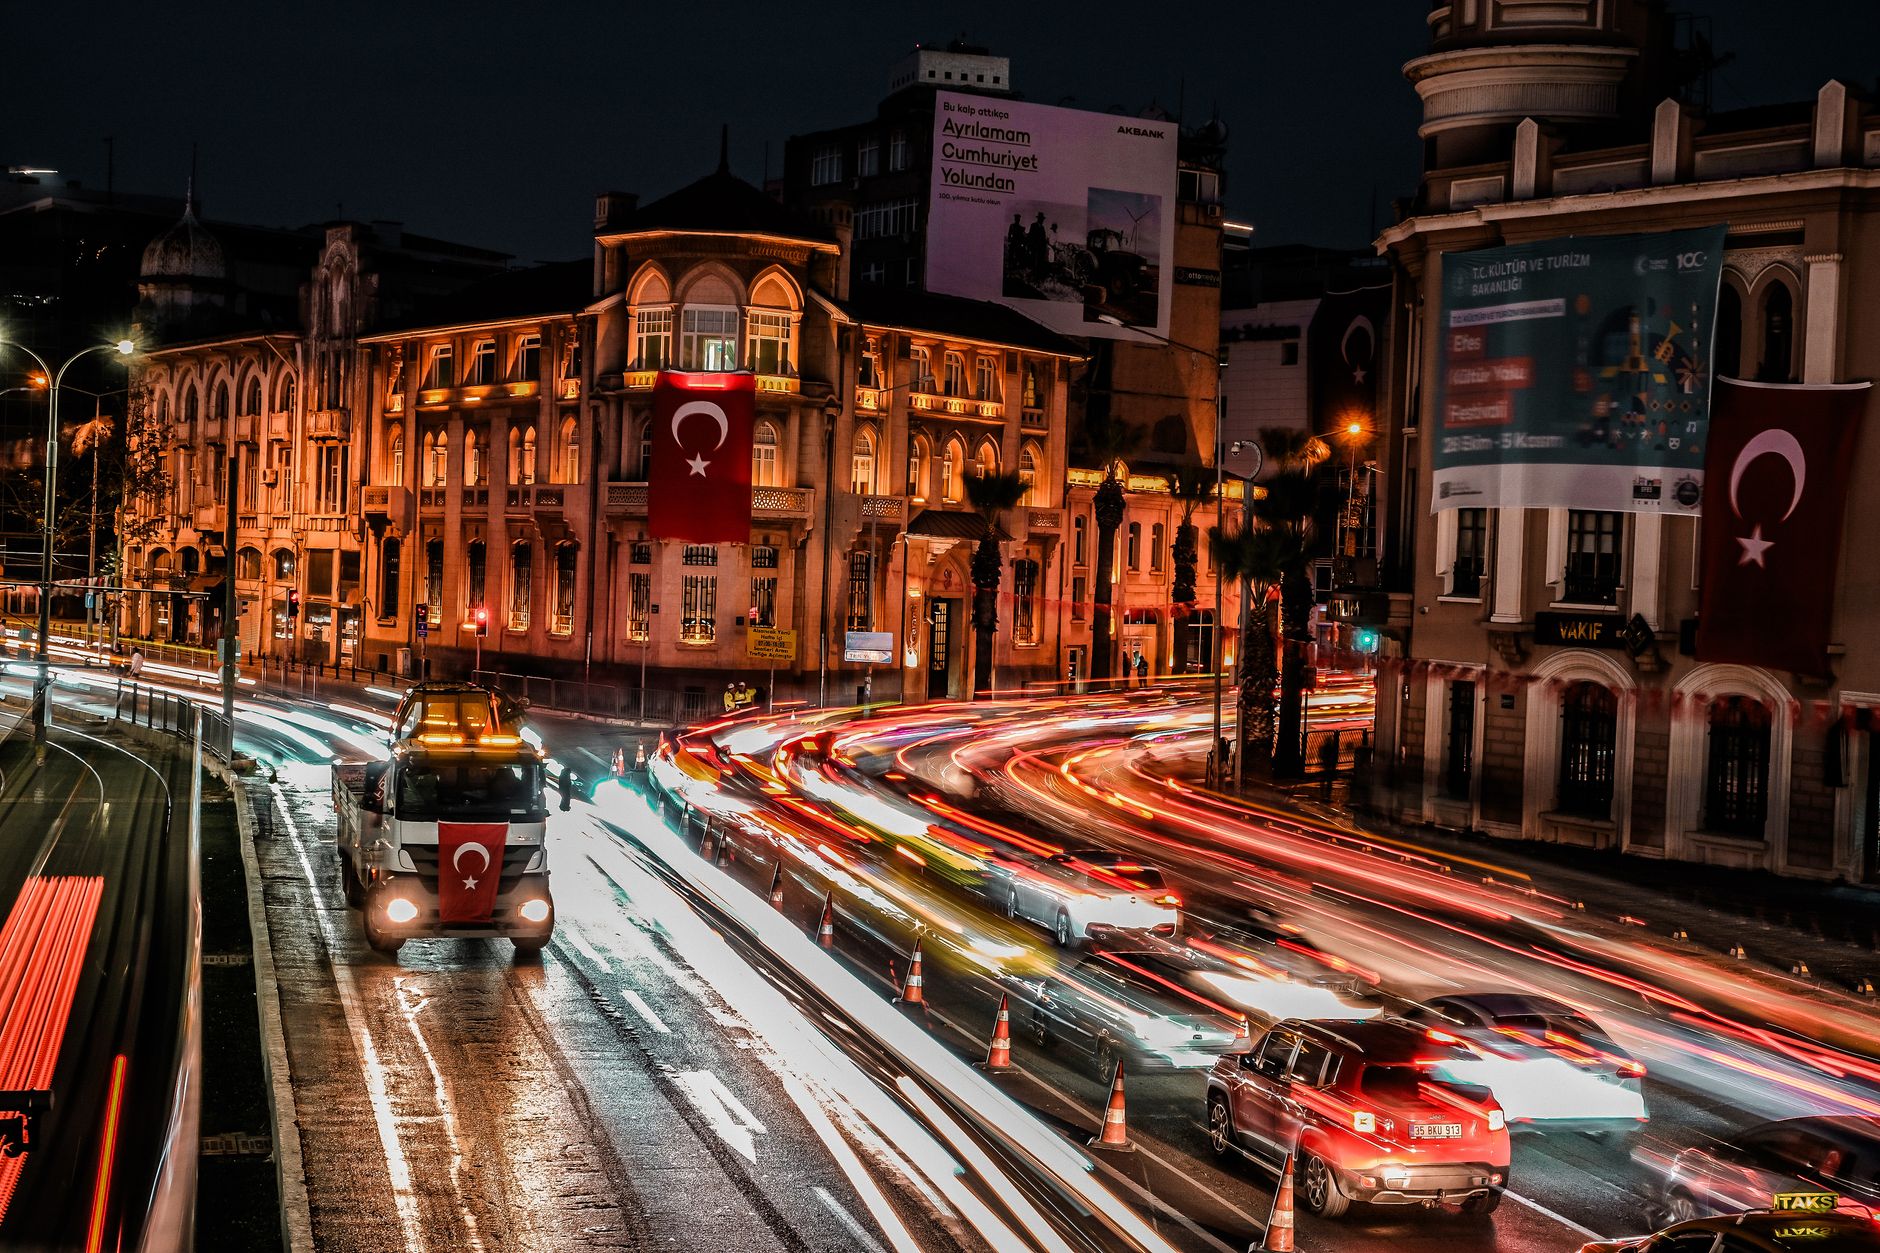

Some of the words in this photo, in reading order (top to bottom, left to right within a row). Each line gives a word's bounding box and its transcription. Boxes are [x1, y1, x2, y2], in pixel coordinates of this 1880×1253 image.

[943, 102, 955, 112] Bu
[957, 104, 976, 117] kalp
[978, 108, 1009, 120] attıkça
[942, 117, 1031, 144] Ayrılamam
[1117, 126, 1165, 139] AKBANK
[942, 142, 1038, 172] Cumhuriyet
[941, 167, 1015, 191] Yolundan
[1472, 267, 1487, 280] T.C.
[1489, 258, 1527, 278] KÜLTÜR
[1530, 258, 1544, 272] VE
[1547, 250, 1591, 270] TURİZM
[1472, 275, 1522, 296] BAKANLIĞI
[1558, 620, 1603, 641] VAKIF
[1414, 1126, 1425, 1136] 35
[1428, 1125, 1442, 1135] BKU
[1446, 1125, 1460, 1135] 913
